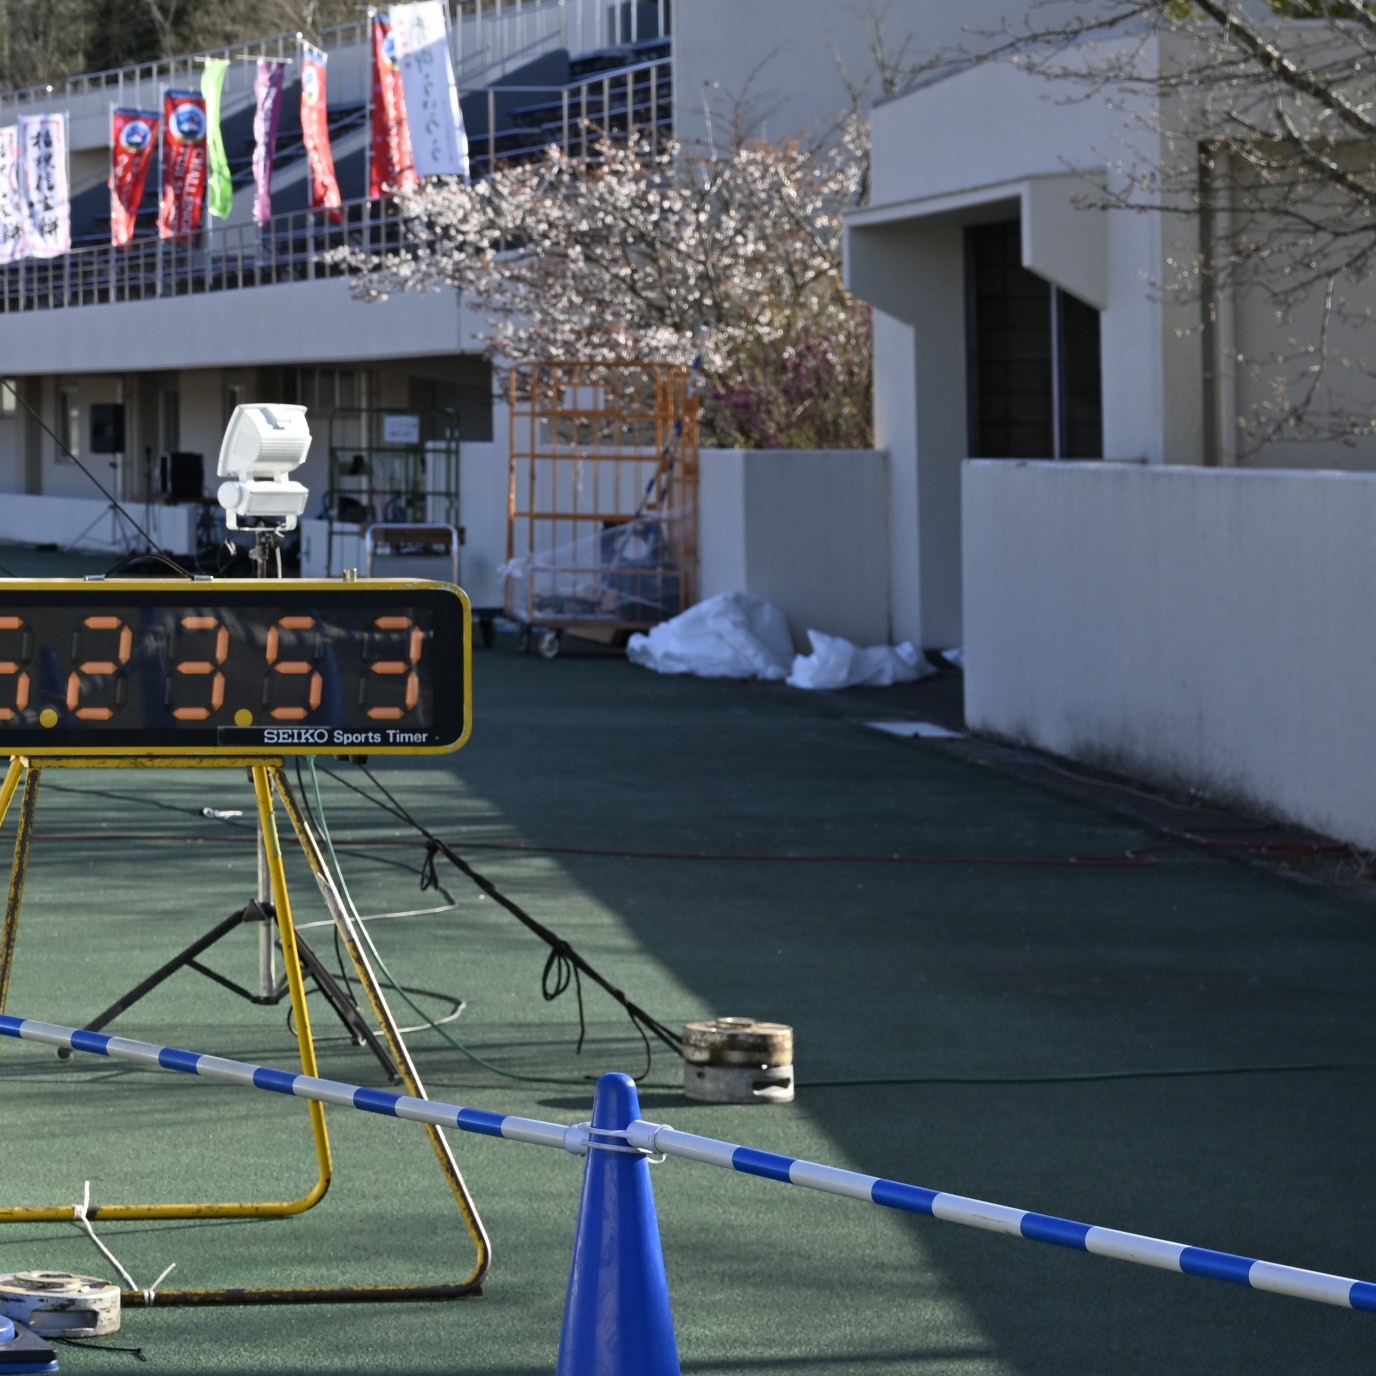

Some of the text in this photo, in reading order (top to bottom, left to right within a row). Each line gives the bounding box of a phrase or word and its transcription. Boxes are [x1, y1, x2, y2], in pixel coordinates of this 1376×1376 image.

[263, 728, 428, 745] SEIKO Sports Timer
